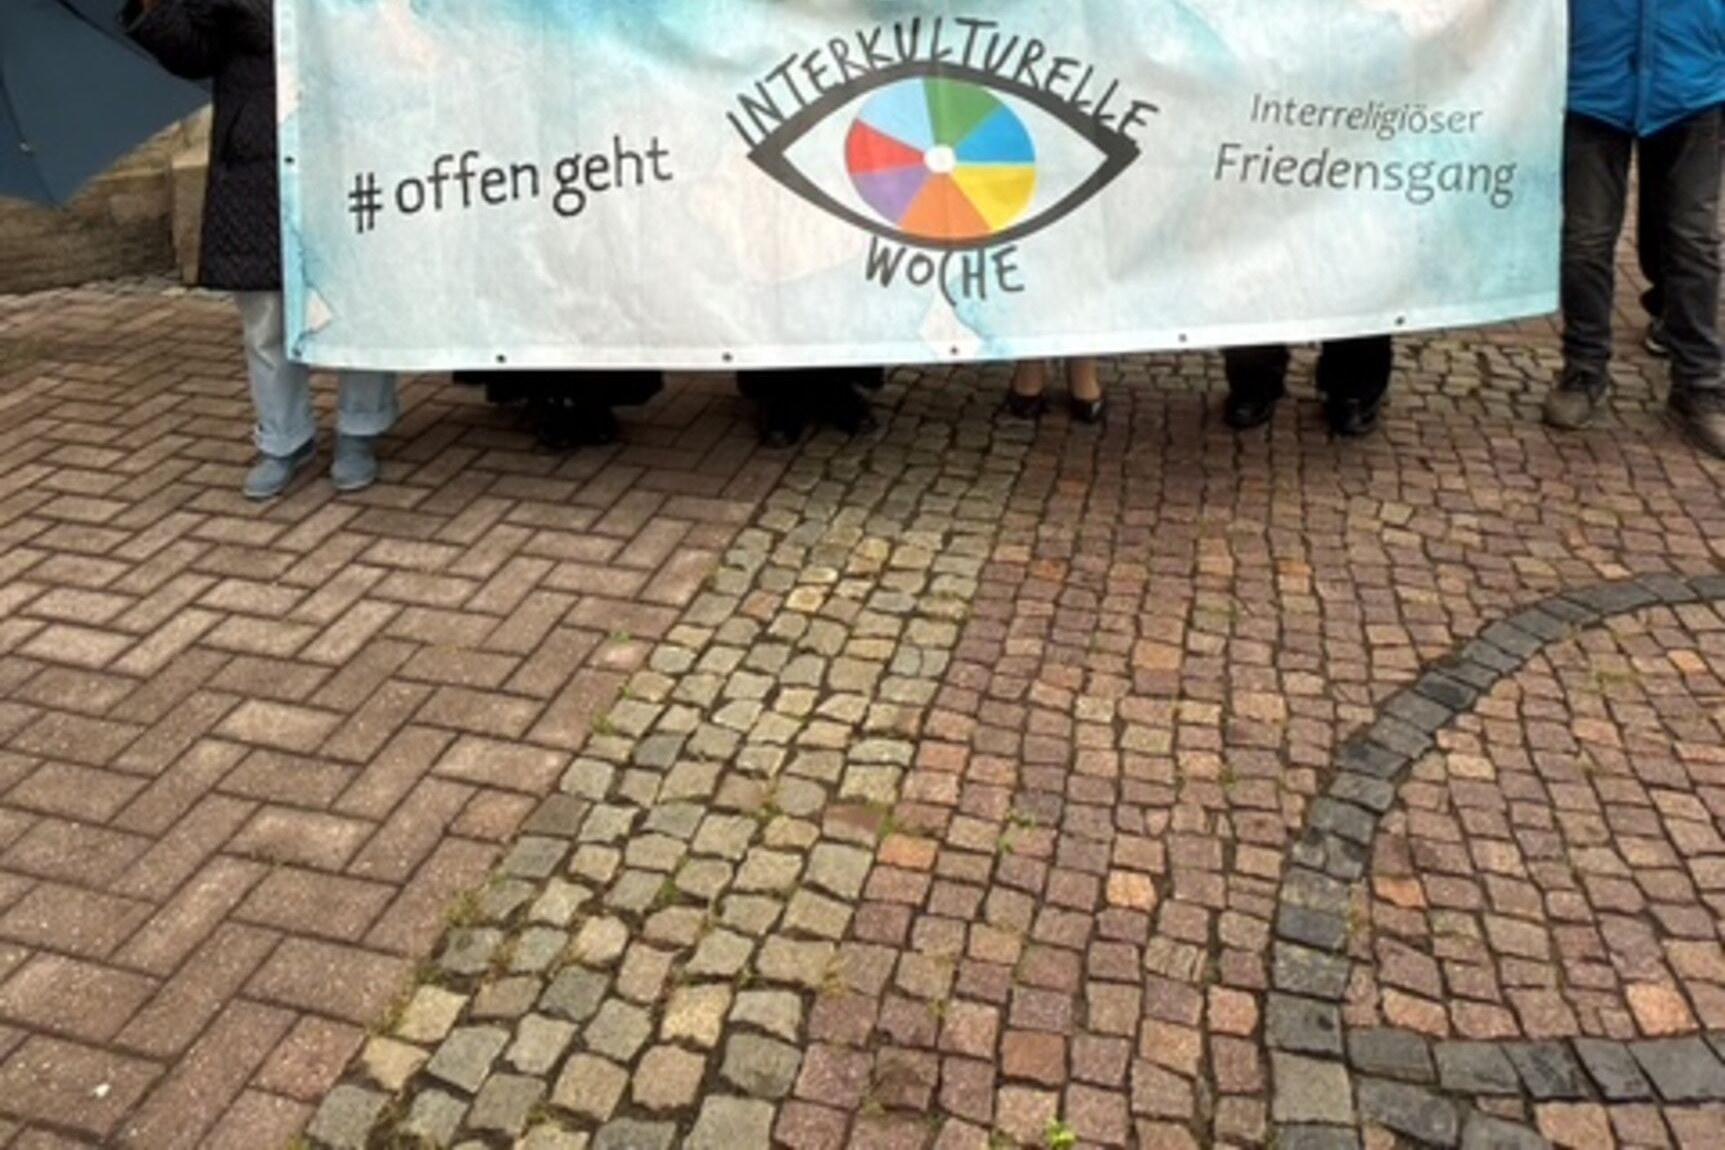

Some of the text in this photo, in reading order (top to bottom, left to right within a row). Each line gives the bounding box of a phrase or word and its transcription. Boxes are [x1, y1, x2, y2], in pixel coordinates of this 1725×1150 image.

[727, 16, 1159, 151] INTERKULTURELLE
[1250, 92, 1484, 141] Interreligiöser
[553, 135, 673, 217] geht
[1213, 142, 1518, 208] Friedensgang
[865, 236, 1025, 307] WOCHE
